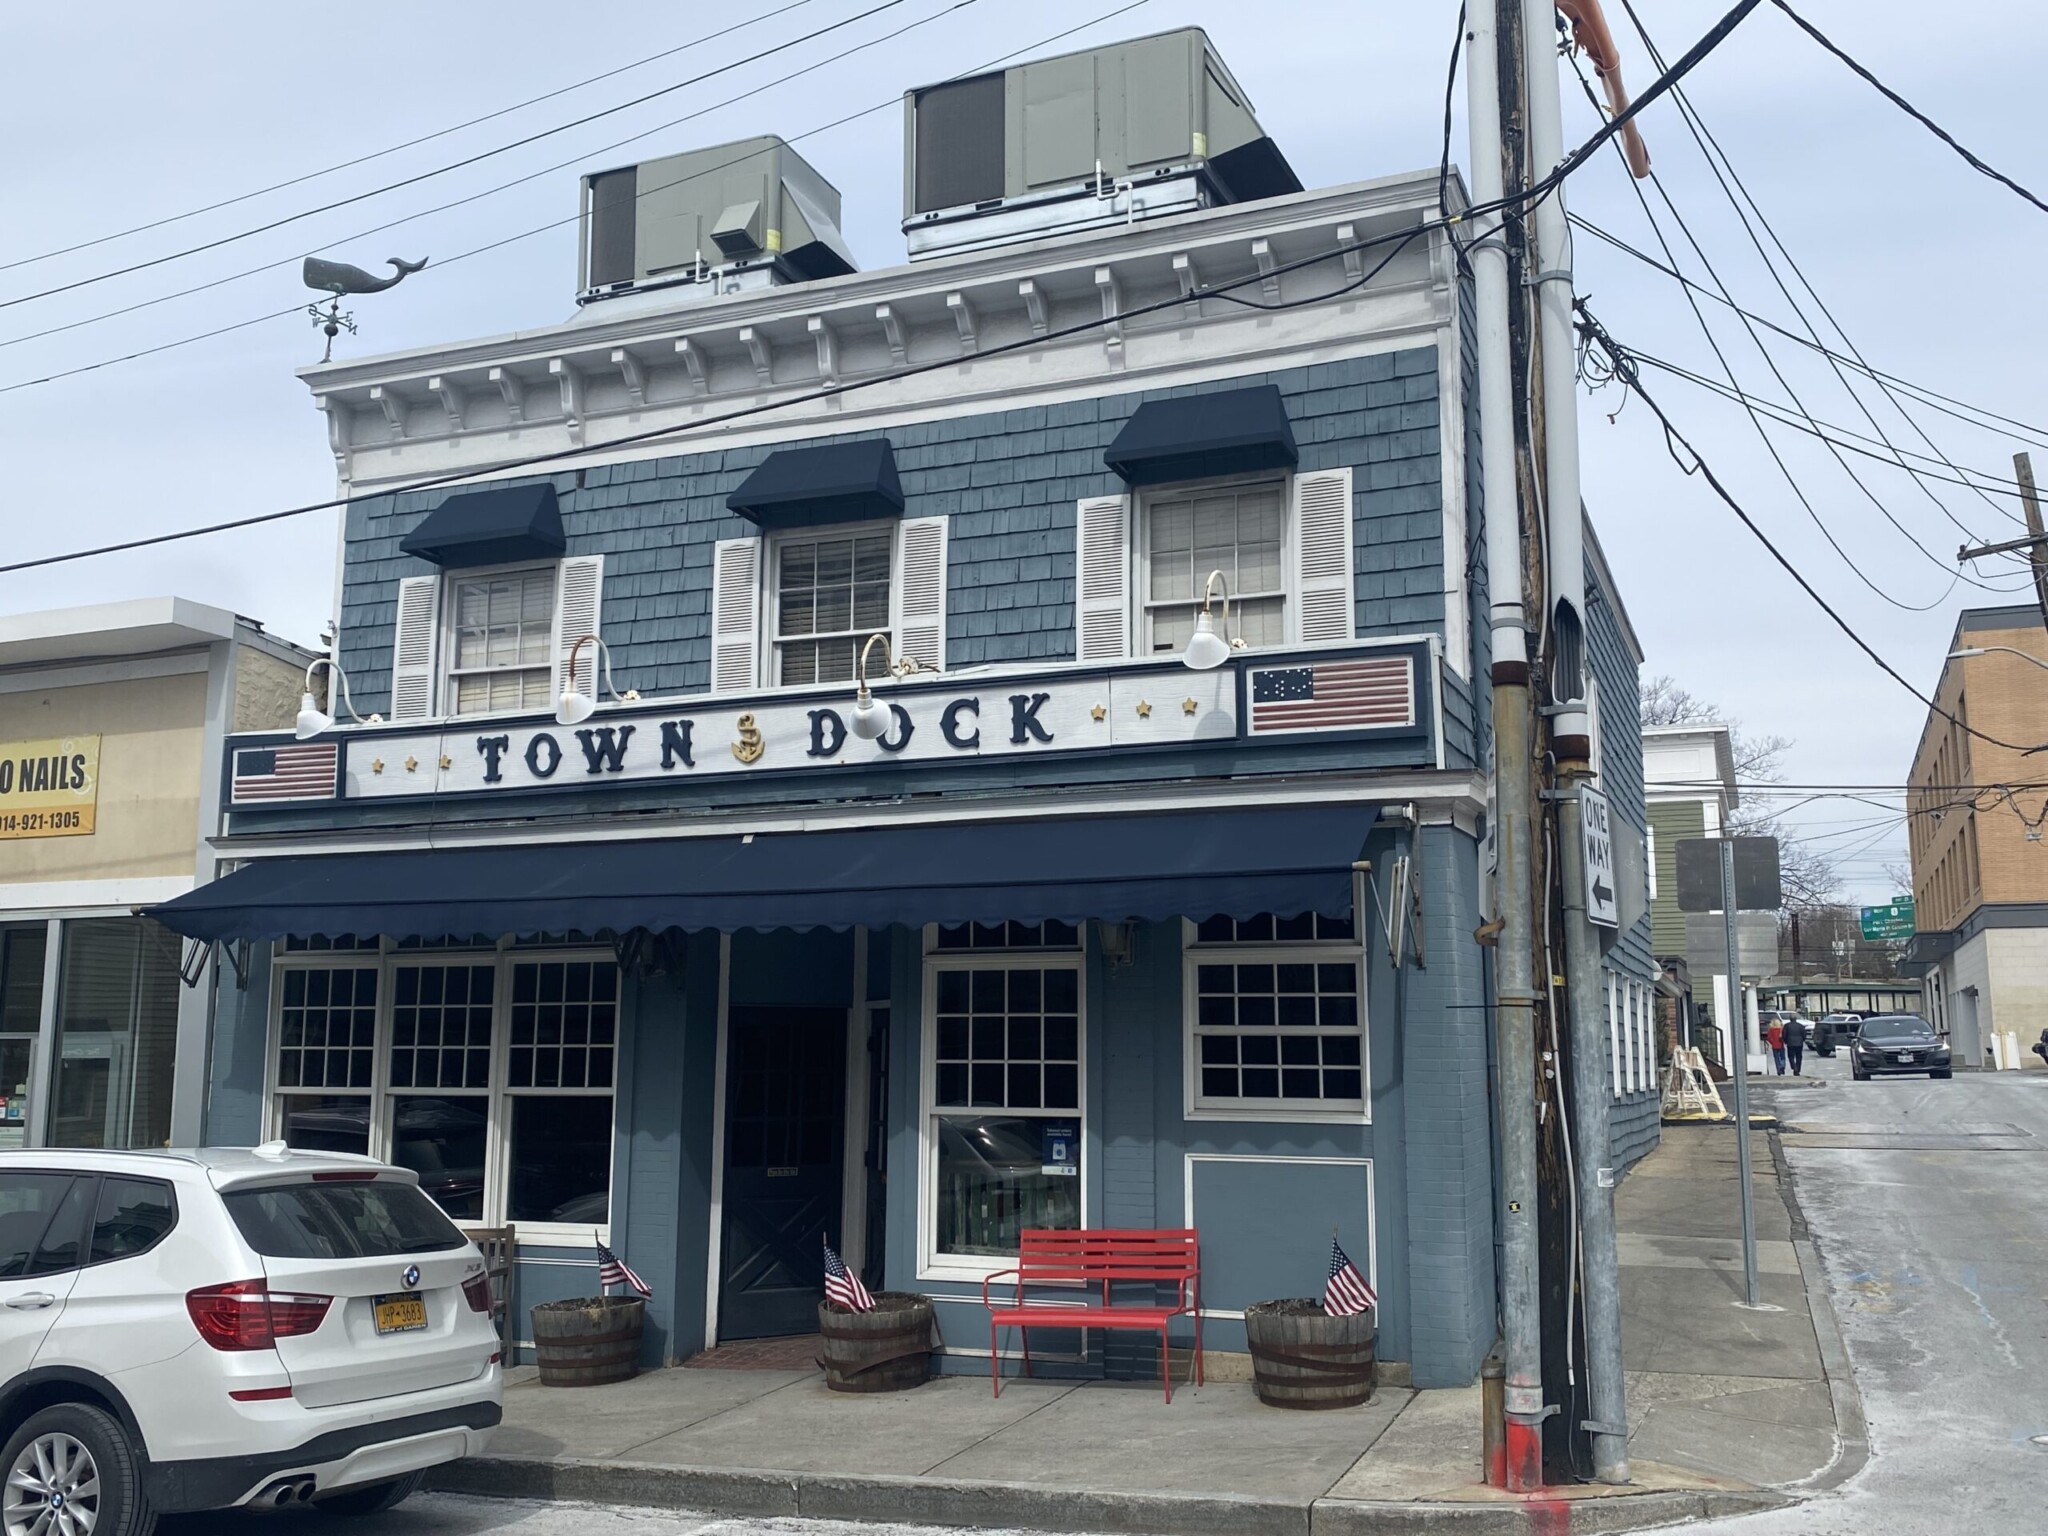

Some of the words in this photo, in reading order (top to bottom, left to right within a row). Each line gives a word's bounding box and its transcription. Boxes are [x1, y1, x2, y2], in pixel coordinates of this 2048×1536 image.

[477, 719, 696, 782] TOWN
[806, 692, 1055, 756] DOCK
[19, 754, 85, 792] NAILS
[0, 811, 80, 831] 14-921-1305
[1585, 797, 1607, 834] ONE
[1587, 834, 1609, 869] WAY
[381, 1305, 395, 1324] JHP
[400, 1302, 422, 1322] 3683
